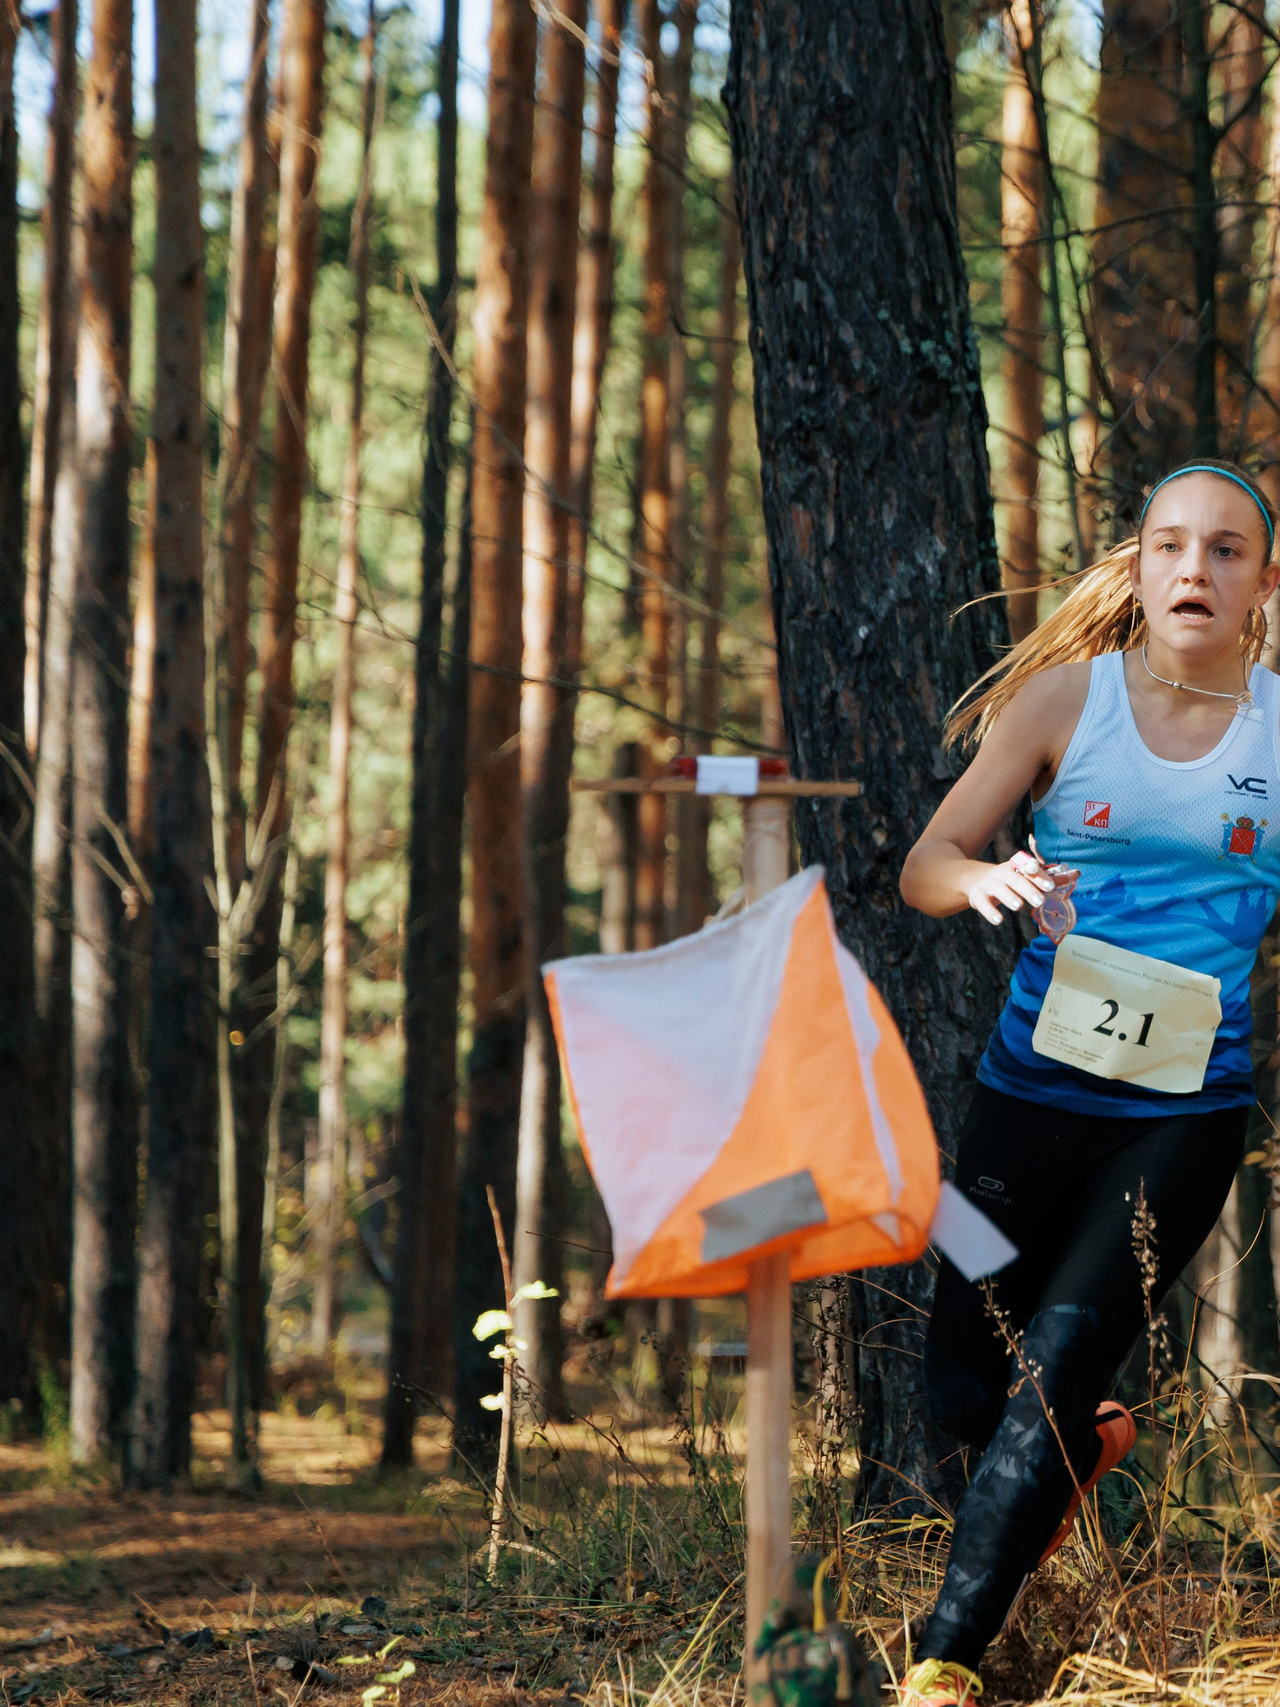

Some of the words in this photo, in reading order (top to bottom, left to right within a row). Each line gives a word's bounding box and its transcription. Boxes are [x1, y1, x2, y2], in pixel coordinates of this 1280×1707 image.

[1226, 773, 1267, 794] VC
[1086, 802, 1096, 811] 31
[1066, 829, 1130, 846] Saint-Petersburg
[1092, 998, 1154, 1048] 2.1
